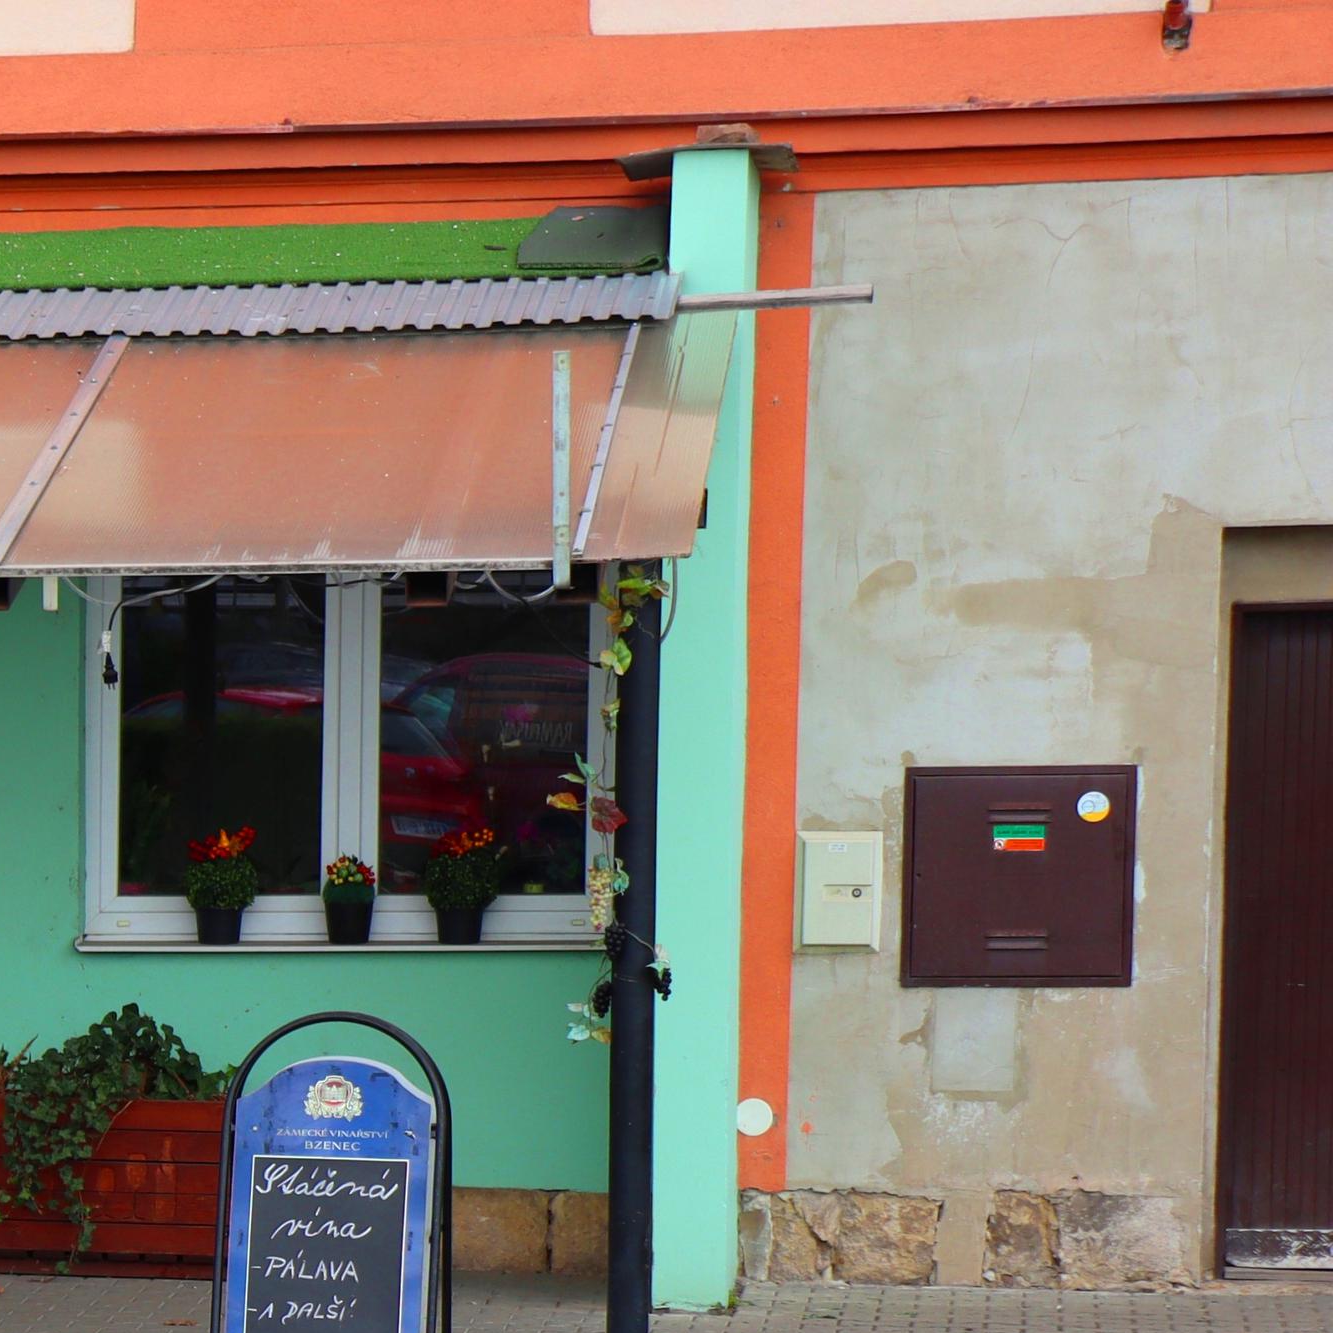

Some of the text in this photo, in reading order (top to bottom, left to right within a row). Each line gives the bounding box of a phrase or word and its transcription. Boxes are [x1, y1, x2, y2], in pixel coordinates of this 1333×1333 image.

[276, 1126, 389, 1140] ZÁMECKÉ VINAŘSTVÍ
[304, 1140, 361, 1152] BZENEC
[255, 1162, 399, 1200] Stáčená
[271, 1206, 373, 1240] vína
